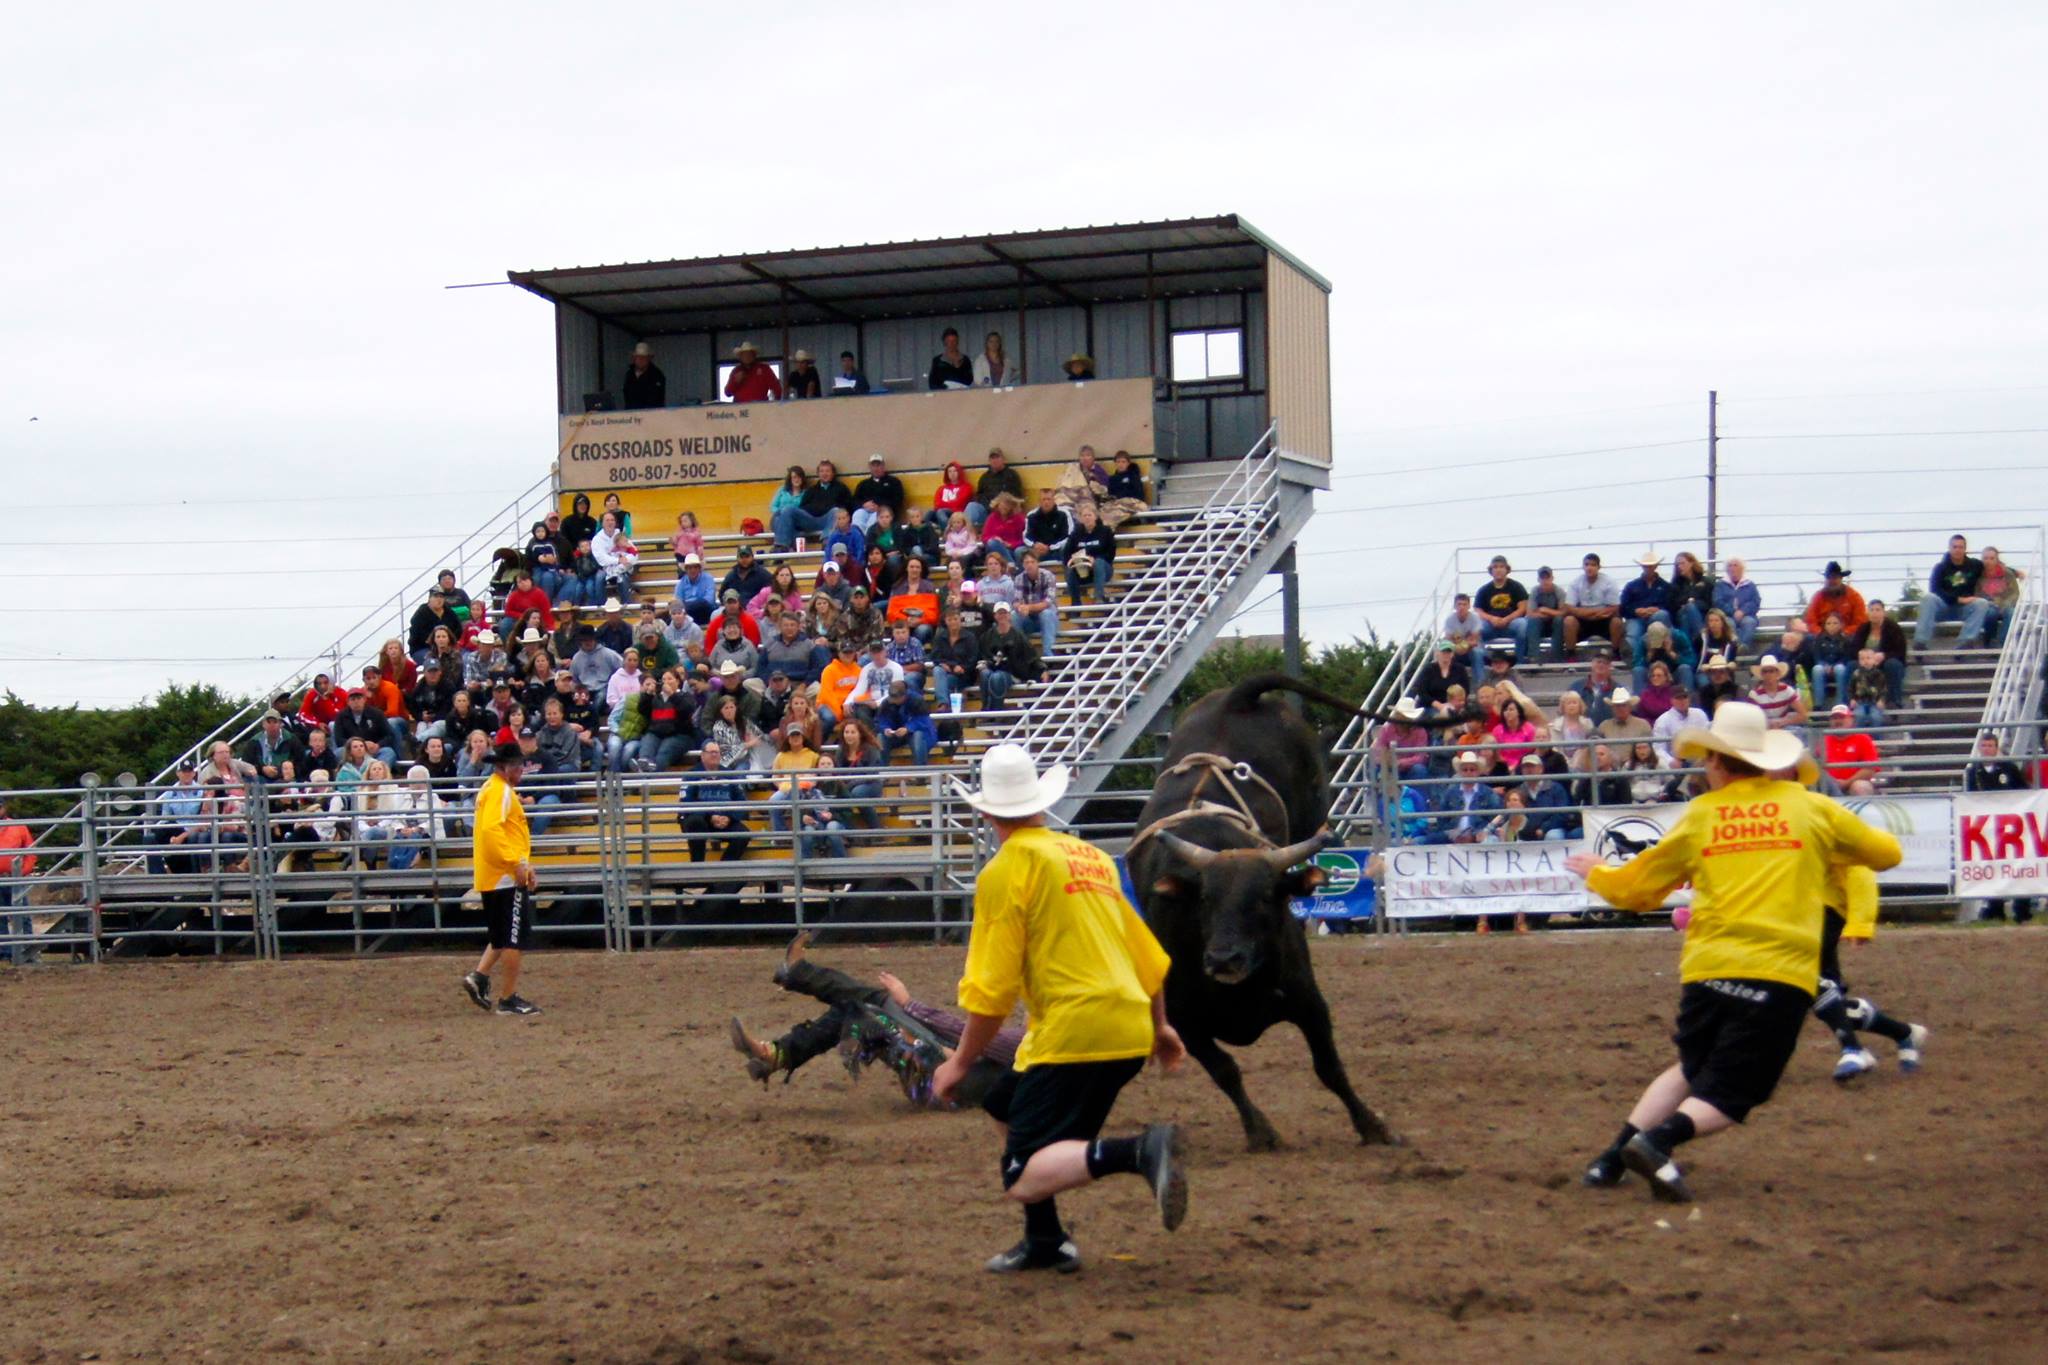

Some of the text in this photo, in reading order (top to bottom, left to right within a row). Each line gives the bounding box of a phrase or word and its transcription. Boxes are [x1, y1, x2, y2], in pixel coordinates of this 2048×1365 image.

[571, 434, 752, 462] CROSSROADS WELDING
[609, 462, 717, 483] 800-807-5002
[1715, 802, 1780, 822] TACO
[1961, 864, 1995, 881] 880
[2001, 862, 2040, 879] Rural
[1395, 875, 1576, 897] FIRE & SAFETY
